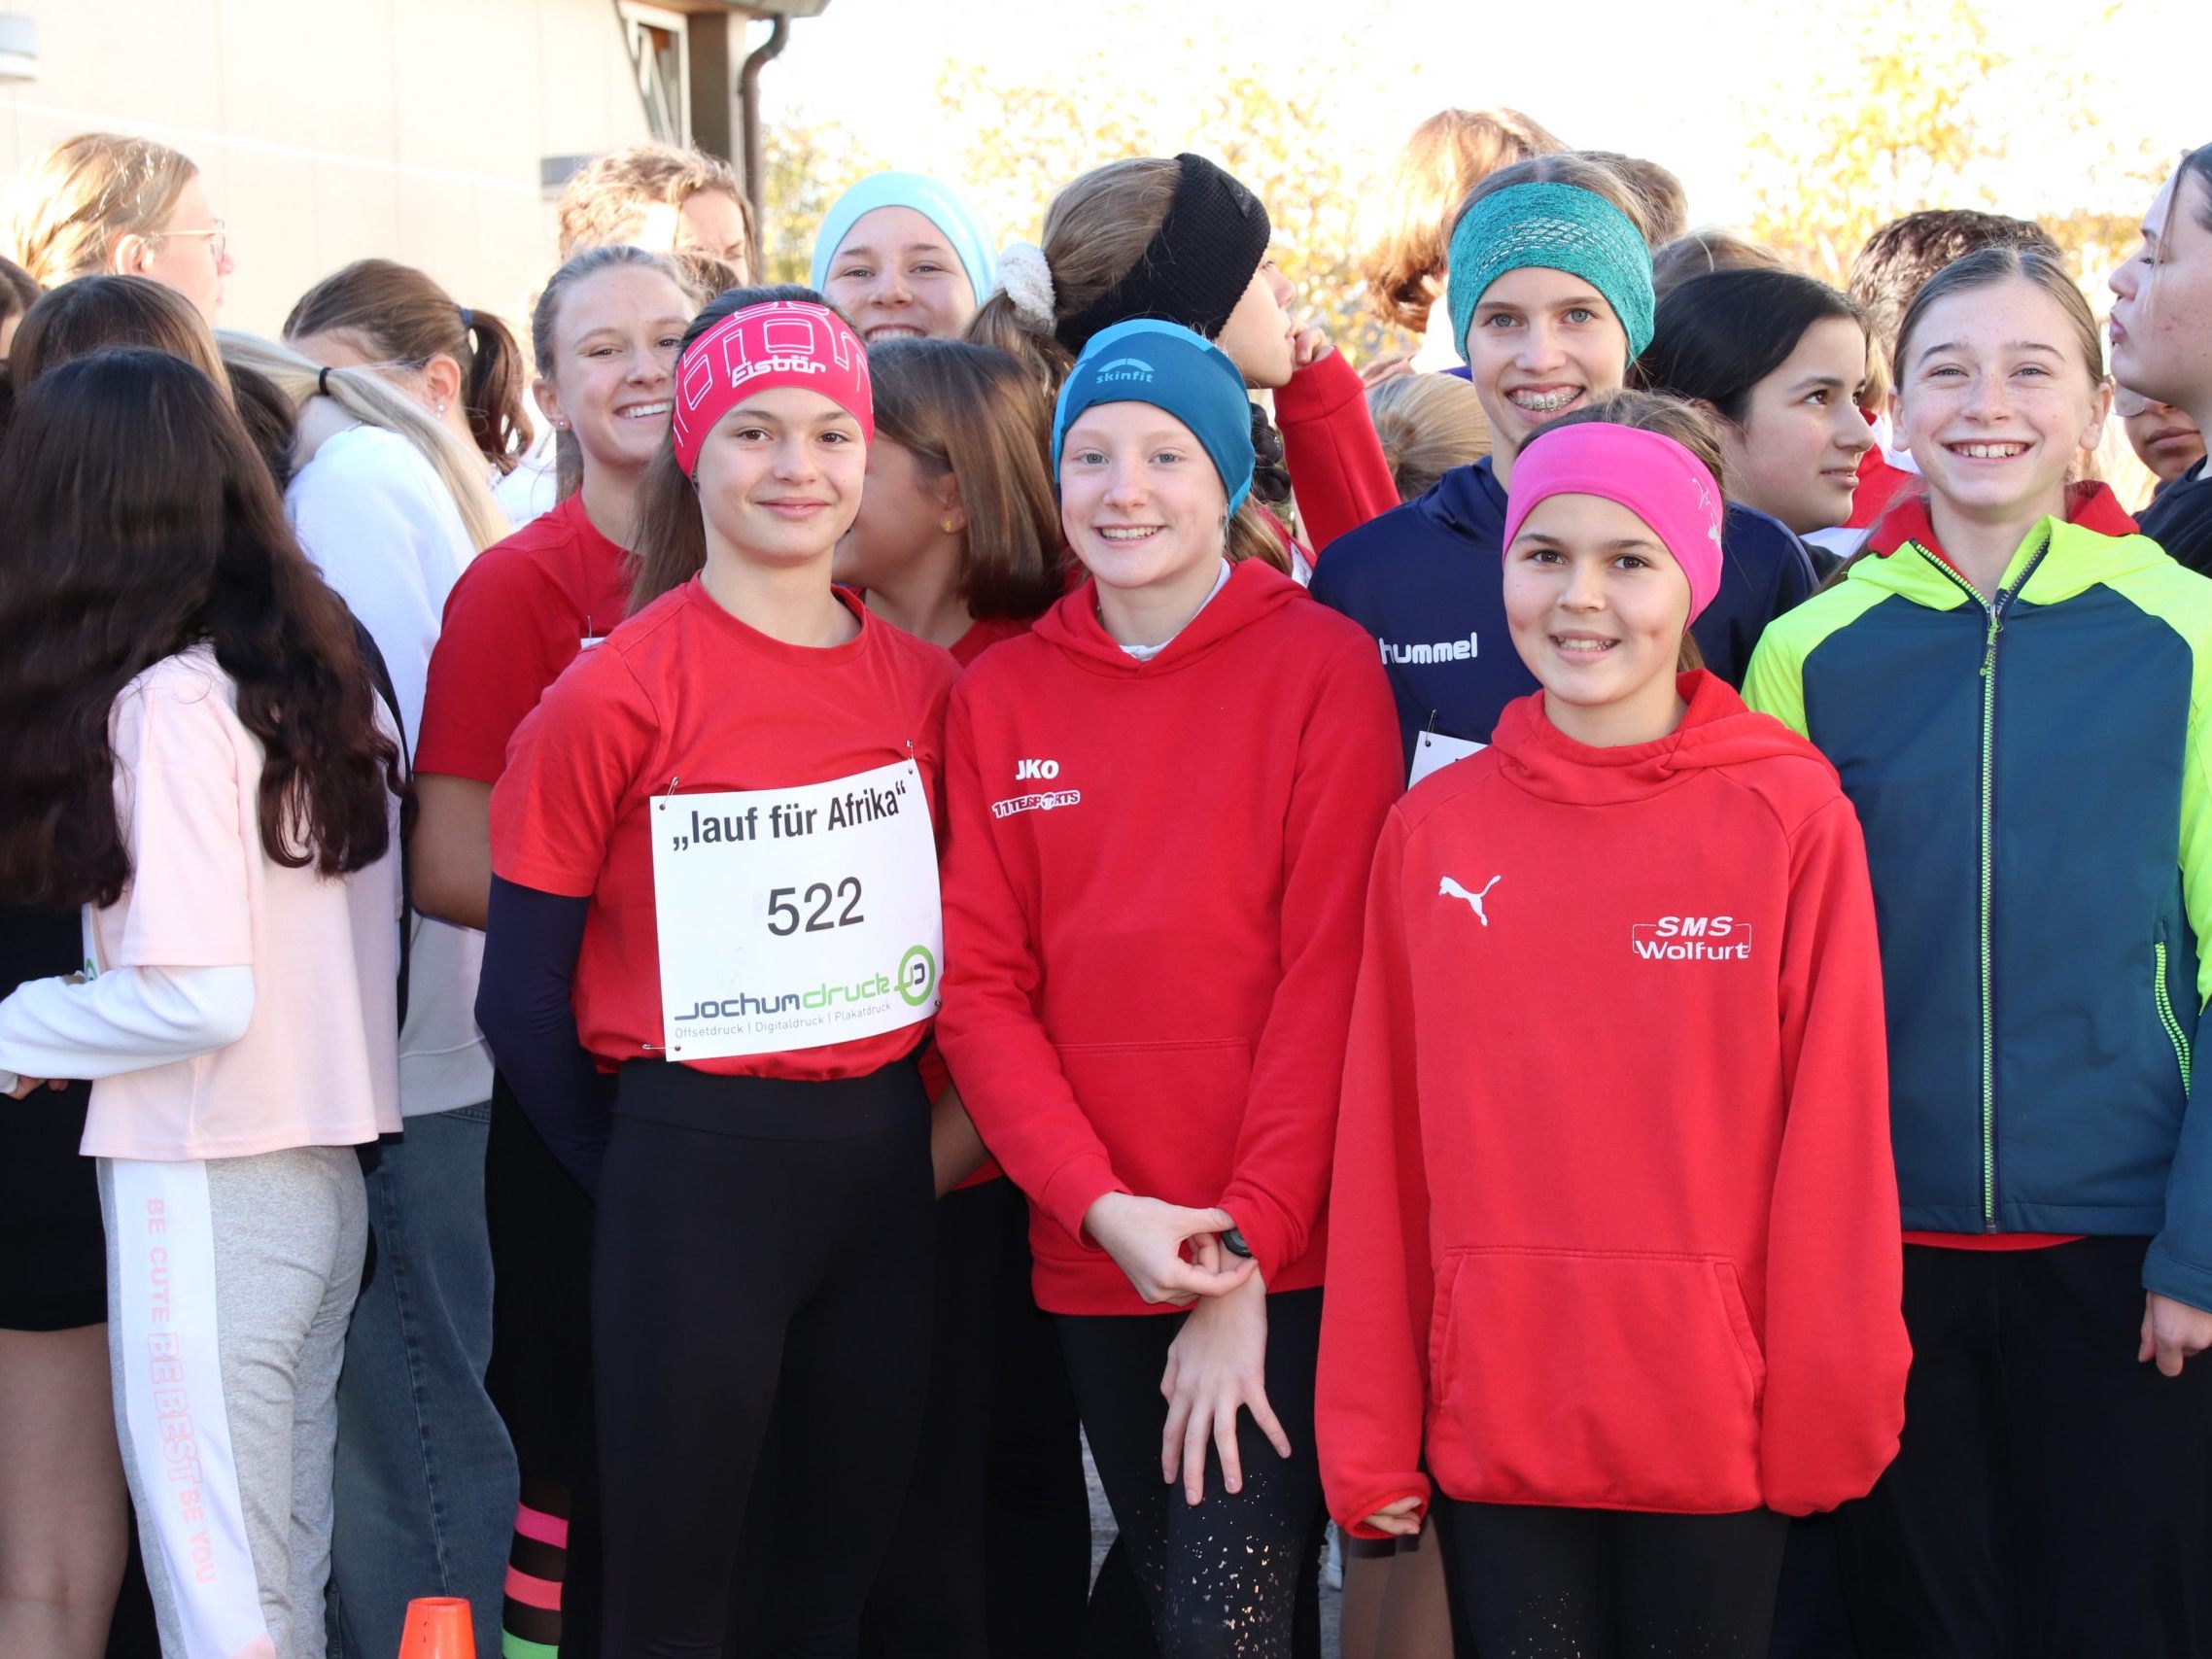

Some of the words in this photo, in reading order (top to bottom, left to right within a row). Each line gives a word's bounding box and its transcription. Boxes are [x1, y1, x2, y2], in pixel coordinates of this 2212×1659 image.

[731, 355, 826, 388] Eisbär
[1095, 370, 1154, 384] skinfit
[1379, 632, 1478, 665] hummel
[1016, 759, 1059, 780] JKO
[769, 803, 817, 839] für
[767, 876, 864, 936] 522
[1655, 916, 1734, 937] SMS
[1635, 940, 1749, 960] Wolfurt
[674, 1023, 743, 1039] Offsetdruck
[755, 1017, 825, 1034] Digitaldruck
[835, 1002, 891, 1022] Plakatdruck
[147, 1198, 166, 1234] BE
[150, 1246, 170, 1324] CUTE
[147, 1332, 185, 1385] BE
[153, 1388, 203, 1485] BEST
[179, 1488, 205, 1524] BE
[189, 1529, 217, 1585] YOU
